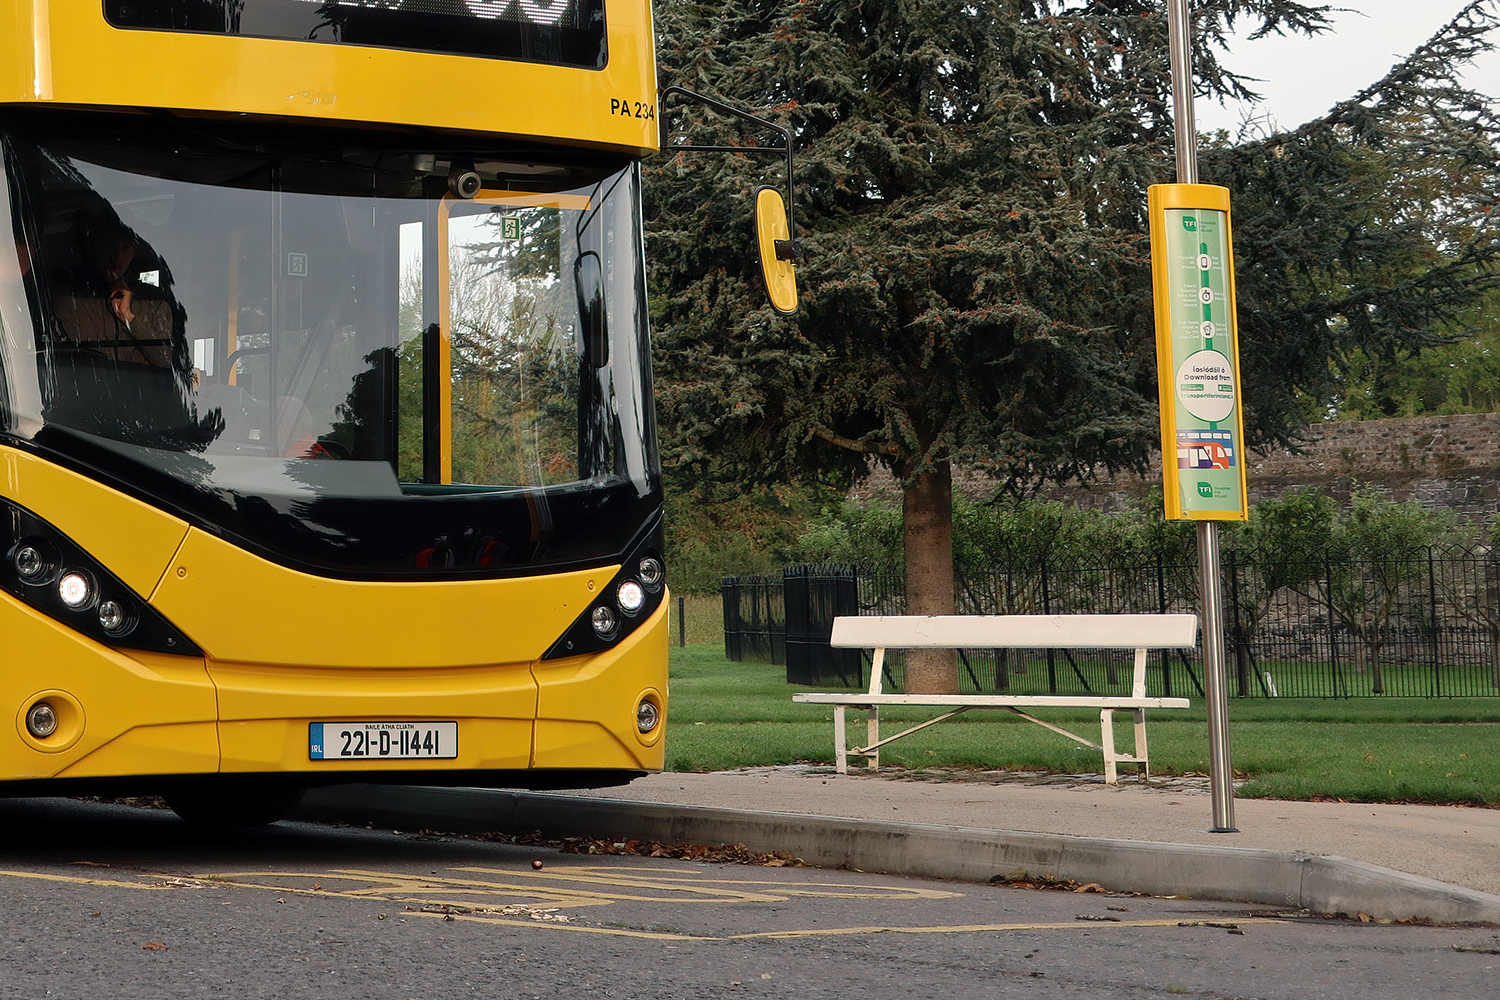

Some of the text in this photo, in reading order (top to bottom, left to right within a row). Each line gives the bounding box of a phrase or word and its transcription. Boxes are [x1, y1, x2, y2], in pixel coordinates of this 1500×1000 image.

[611, 98, 654, 121] PA 234
[311, 745, 323, 753] IRL
[340, 730, 439, 756] 221-D-11441
